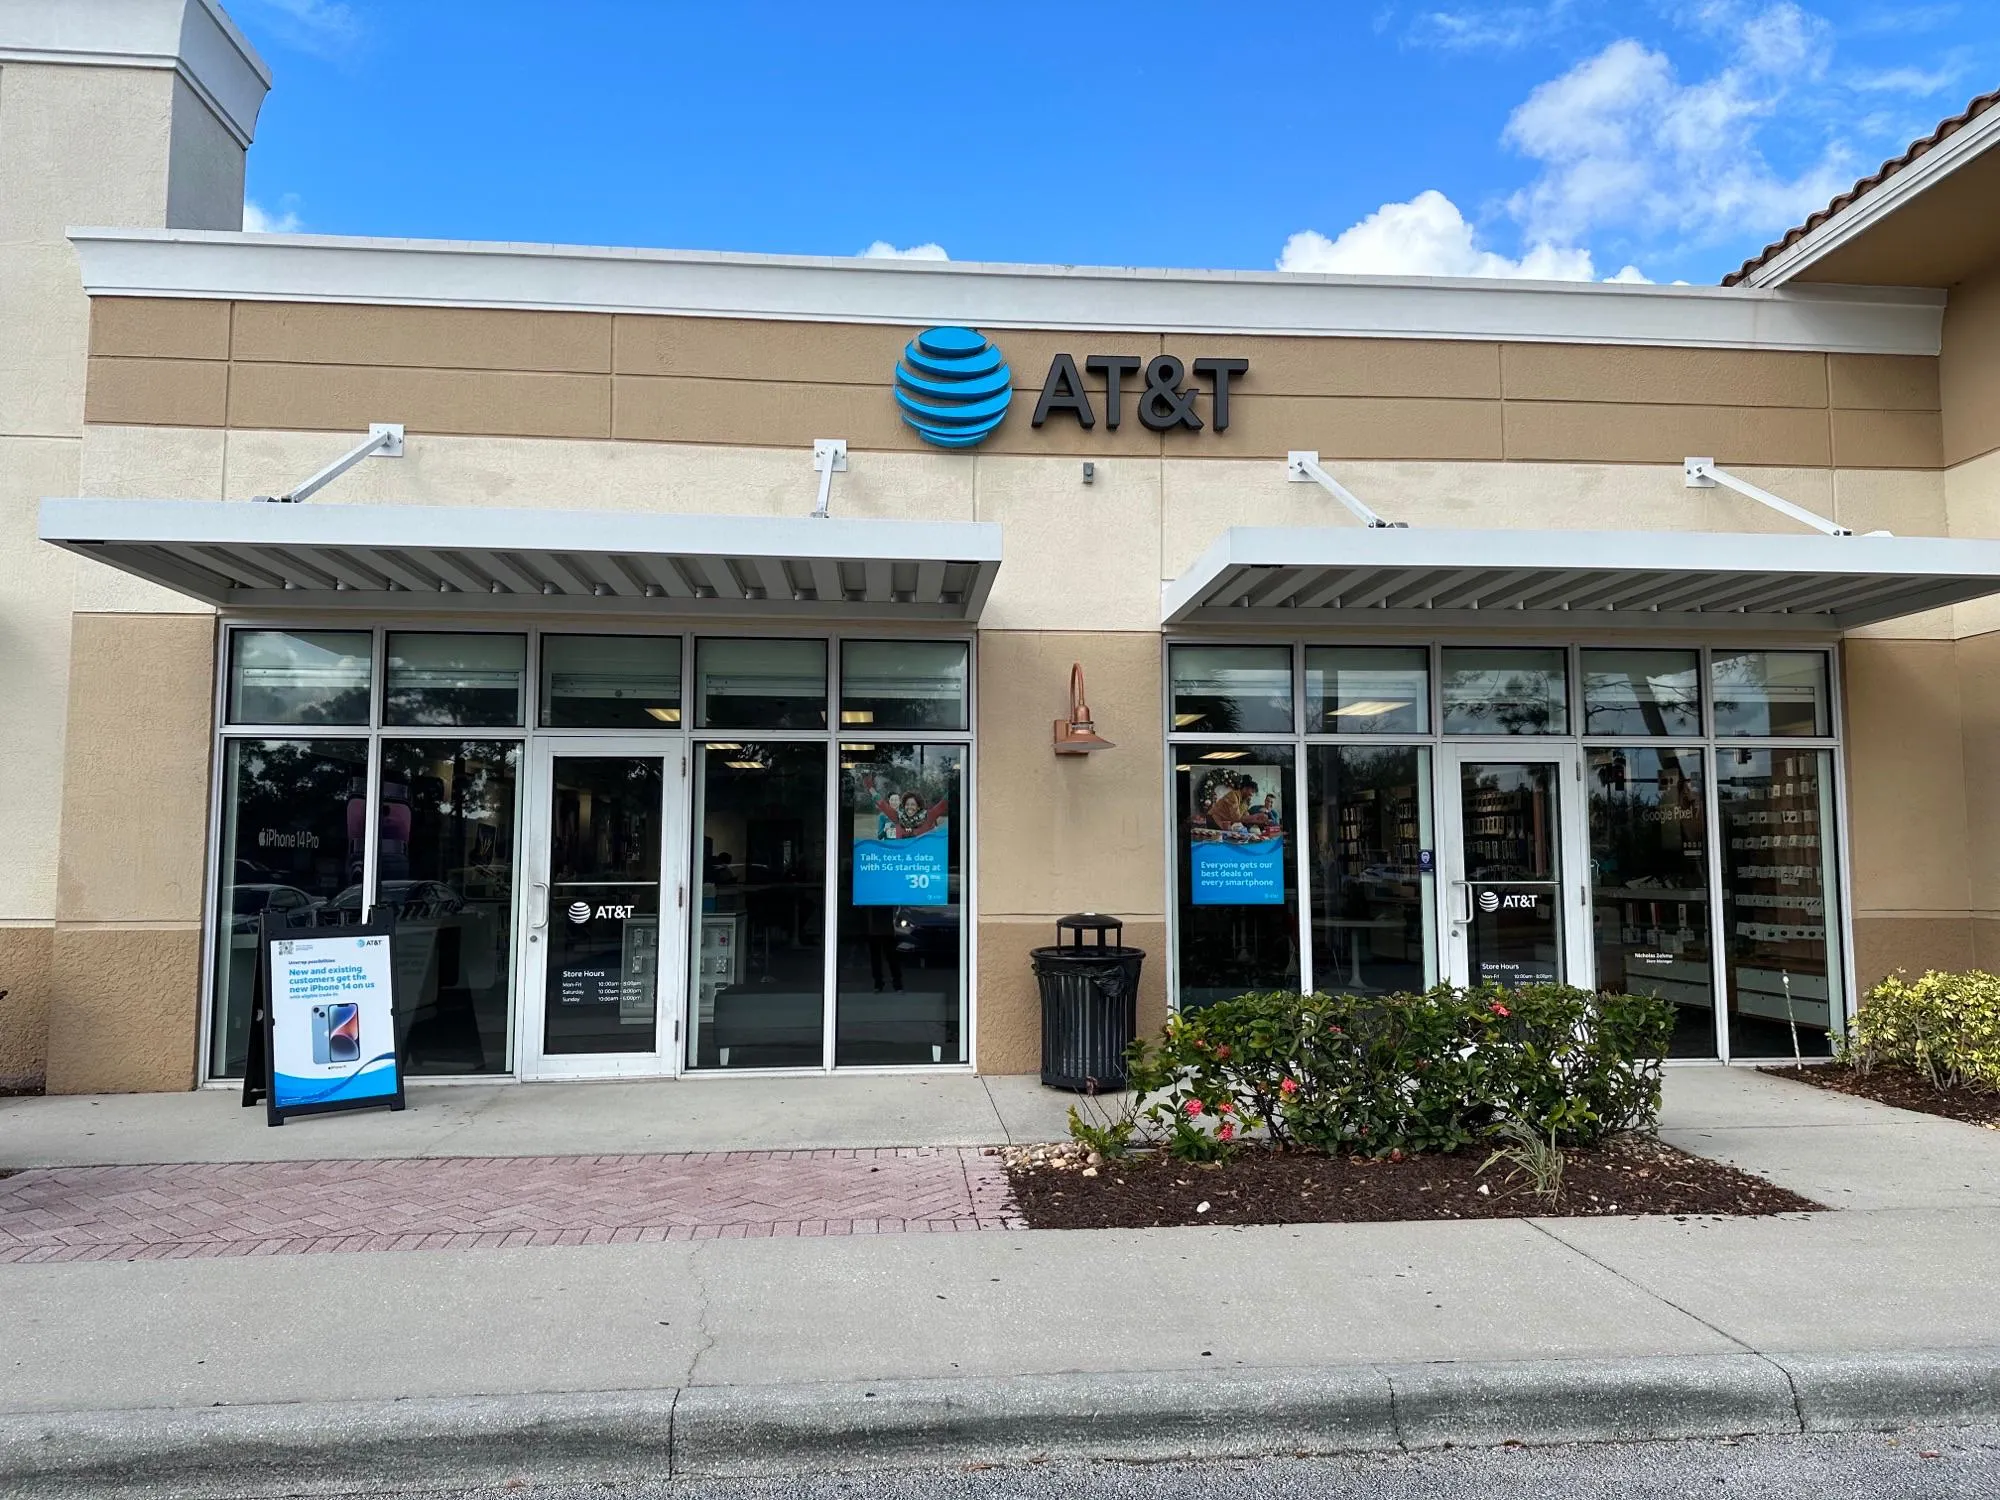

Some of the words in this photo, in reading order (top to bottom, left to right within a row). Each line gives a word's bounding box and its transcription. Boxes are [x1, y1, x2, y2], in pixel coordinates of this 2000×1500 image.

[1031, 353, 1249, 432] AT&T
[1642, 808, 1672, 824] Google
[1674, 806, 1693, 820] Pixel
[266, 828, 295, 848] iPhone
[297, 831, 305, 848] 14
[306, 831, 319, 849] Pro
[860, 853, 881, 862] Talk,
[883, 854, 904, 862] text,
[914, 853, 934, 861] data
[860, 863, 880, 871] with
[882, 863, 893, 871] 5G
[895, 863, 929, 872] starting
[1201, 861, 1238, 870] Everyone
[1240, 862, 1257, 870] gets
[1225, 878, 1274, 887] smartphone
[1503, 894, 1538, 908] AT&T
[595, 905, 635, 919] AT&T
[310, 967, 326, 975] and
[328, 965, 362, 974] existing
[289, 975, 335, 985] customers
[336, 974, 351, 983] get
[353, 973, 367, 981] the
[310, 983, 339, 992] iPhone
